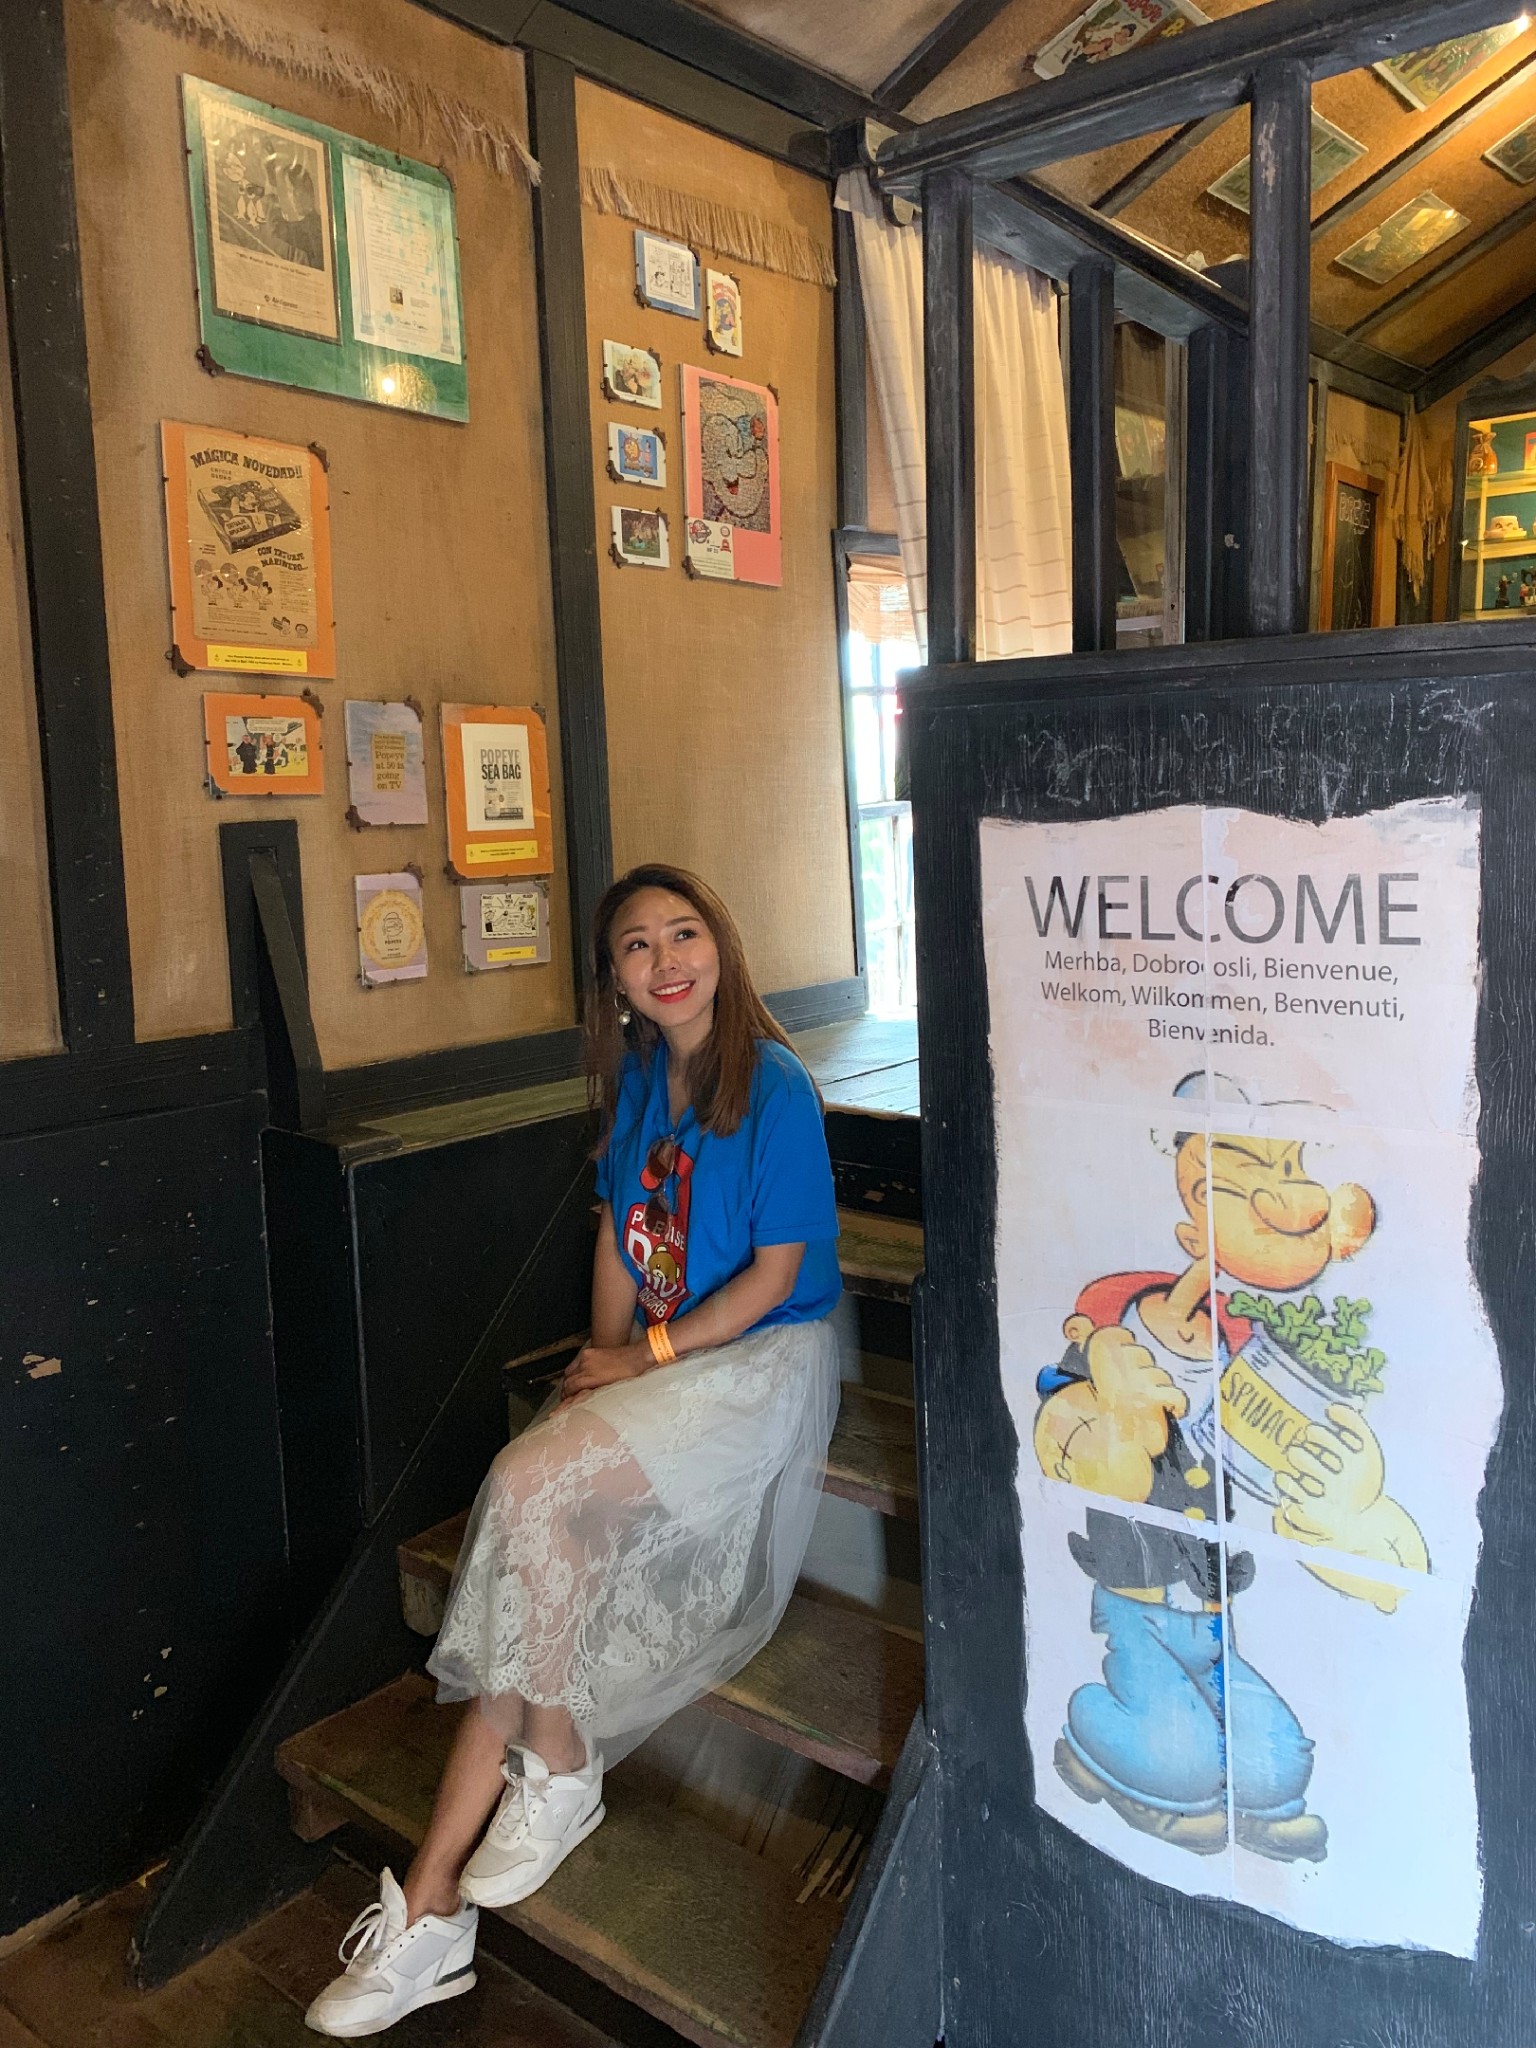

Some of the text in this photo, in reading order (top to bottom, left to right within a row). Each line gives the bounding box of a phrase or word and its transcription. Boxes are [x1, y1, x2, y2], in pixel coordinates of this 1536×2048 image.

[190, 448, 303, 479] MÁGICA NOVEDAD!!
[257, 546, 272, 556] CON
[375, 751, 405, 761] Popeye
[480, 749, 521, 764] POPEYE
[375, 762, 385, 770] at
[481, 764, 522, 780] SEA BAG
[376, 772, 400, 781] going
[389, 781, 402, 789] TV
[1024, 873, 1421, 945] WELCOME
[1045, 950, 1398, 985] Merhba, Dobroosli, Bienvenue,
[1041, 981, 1127, 1007] Welkom,
[1274, 992, 1405, 1022] Benvenuti,
